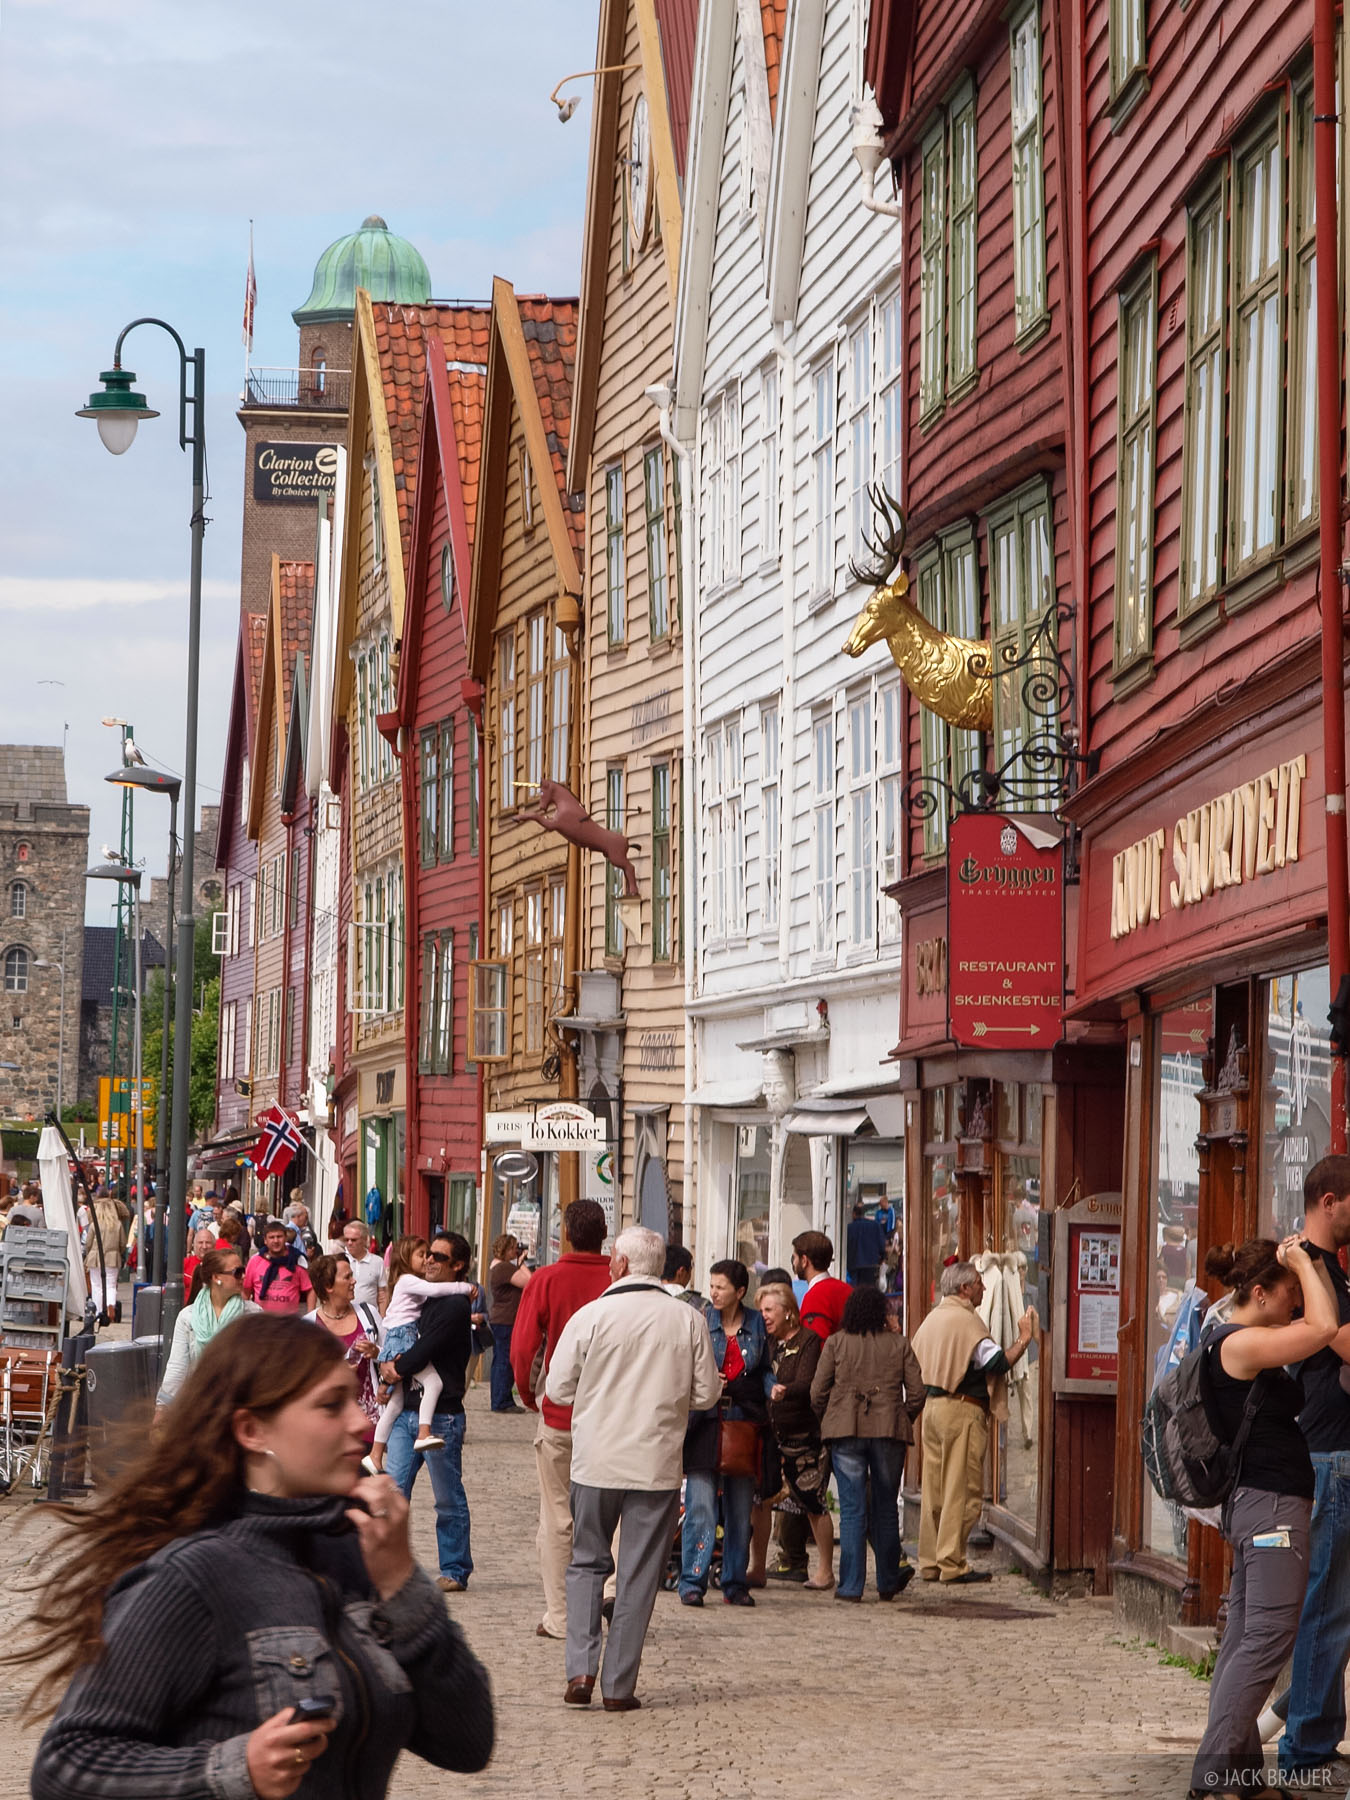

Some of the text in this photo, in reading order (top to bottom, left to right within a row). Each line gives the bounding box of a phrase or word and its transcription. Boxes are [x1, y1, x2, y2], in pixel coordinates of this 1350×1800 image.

[259, 449, 313, 470] Clarion
[272, 487, 282, 497] By
[283, 487, 310, 497] Choice
[959, 961, 1057, 973] RESTAURANT
[1002, 978, 1013, 989] &
[955, 995, 1060, 1007] SKJENKESTUE
[496, 1122, 522, 1132] FRIS
[526, 1121, 600, 1140] To Kokker
[1286, 1165, 1303, 1192] VIKEN
